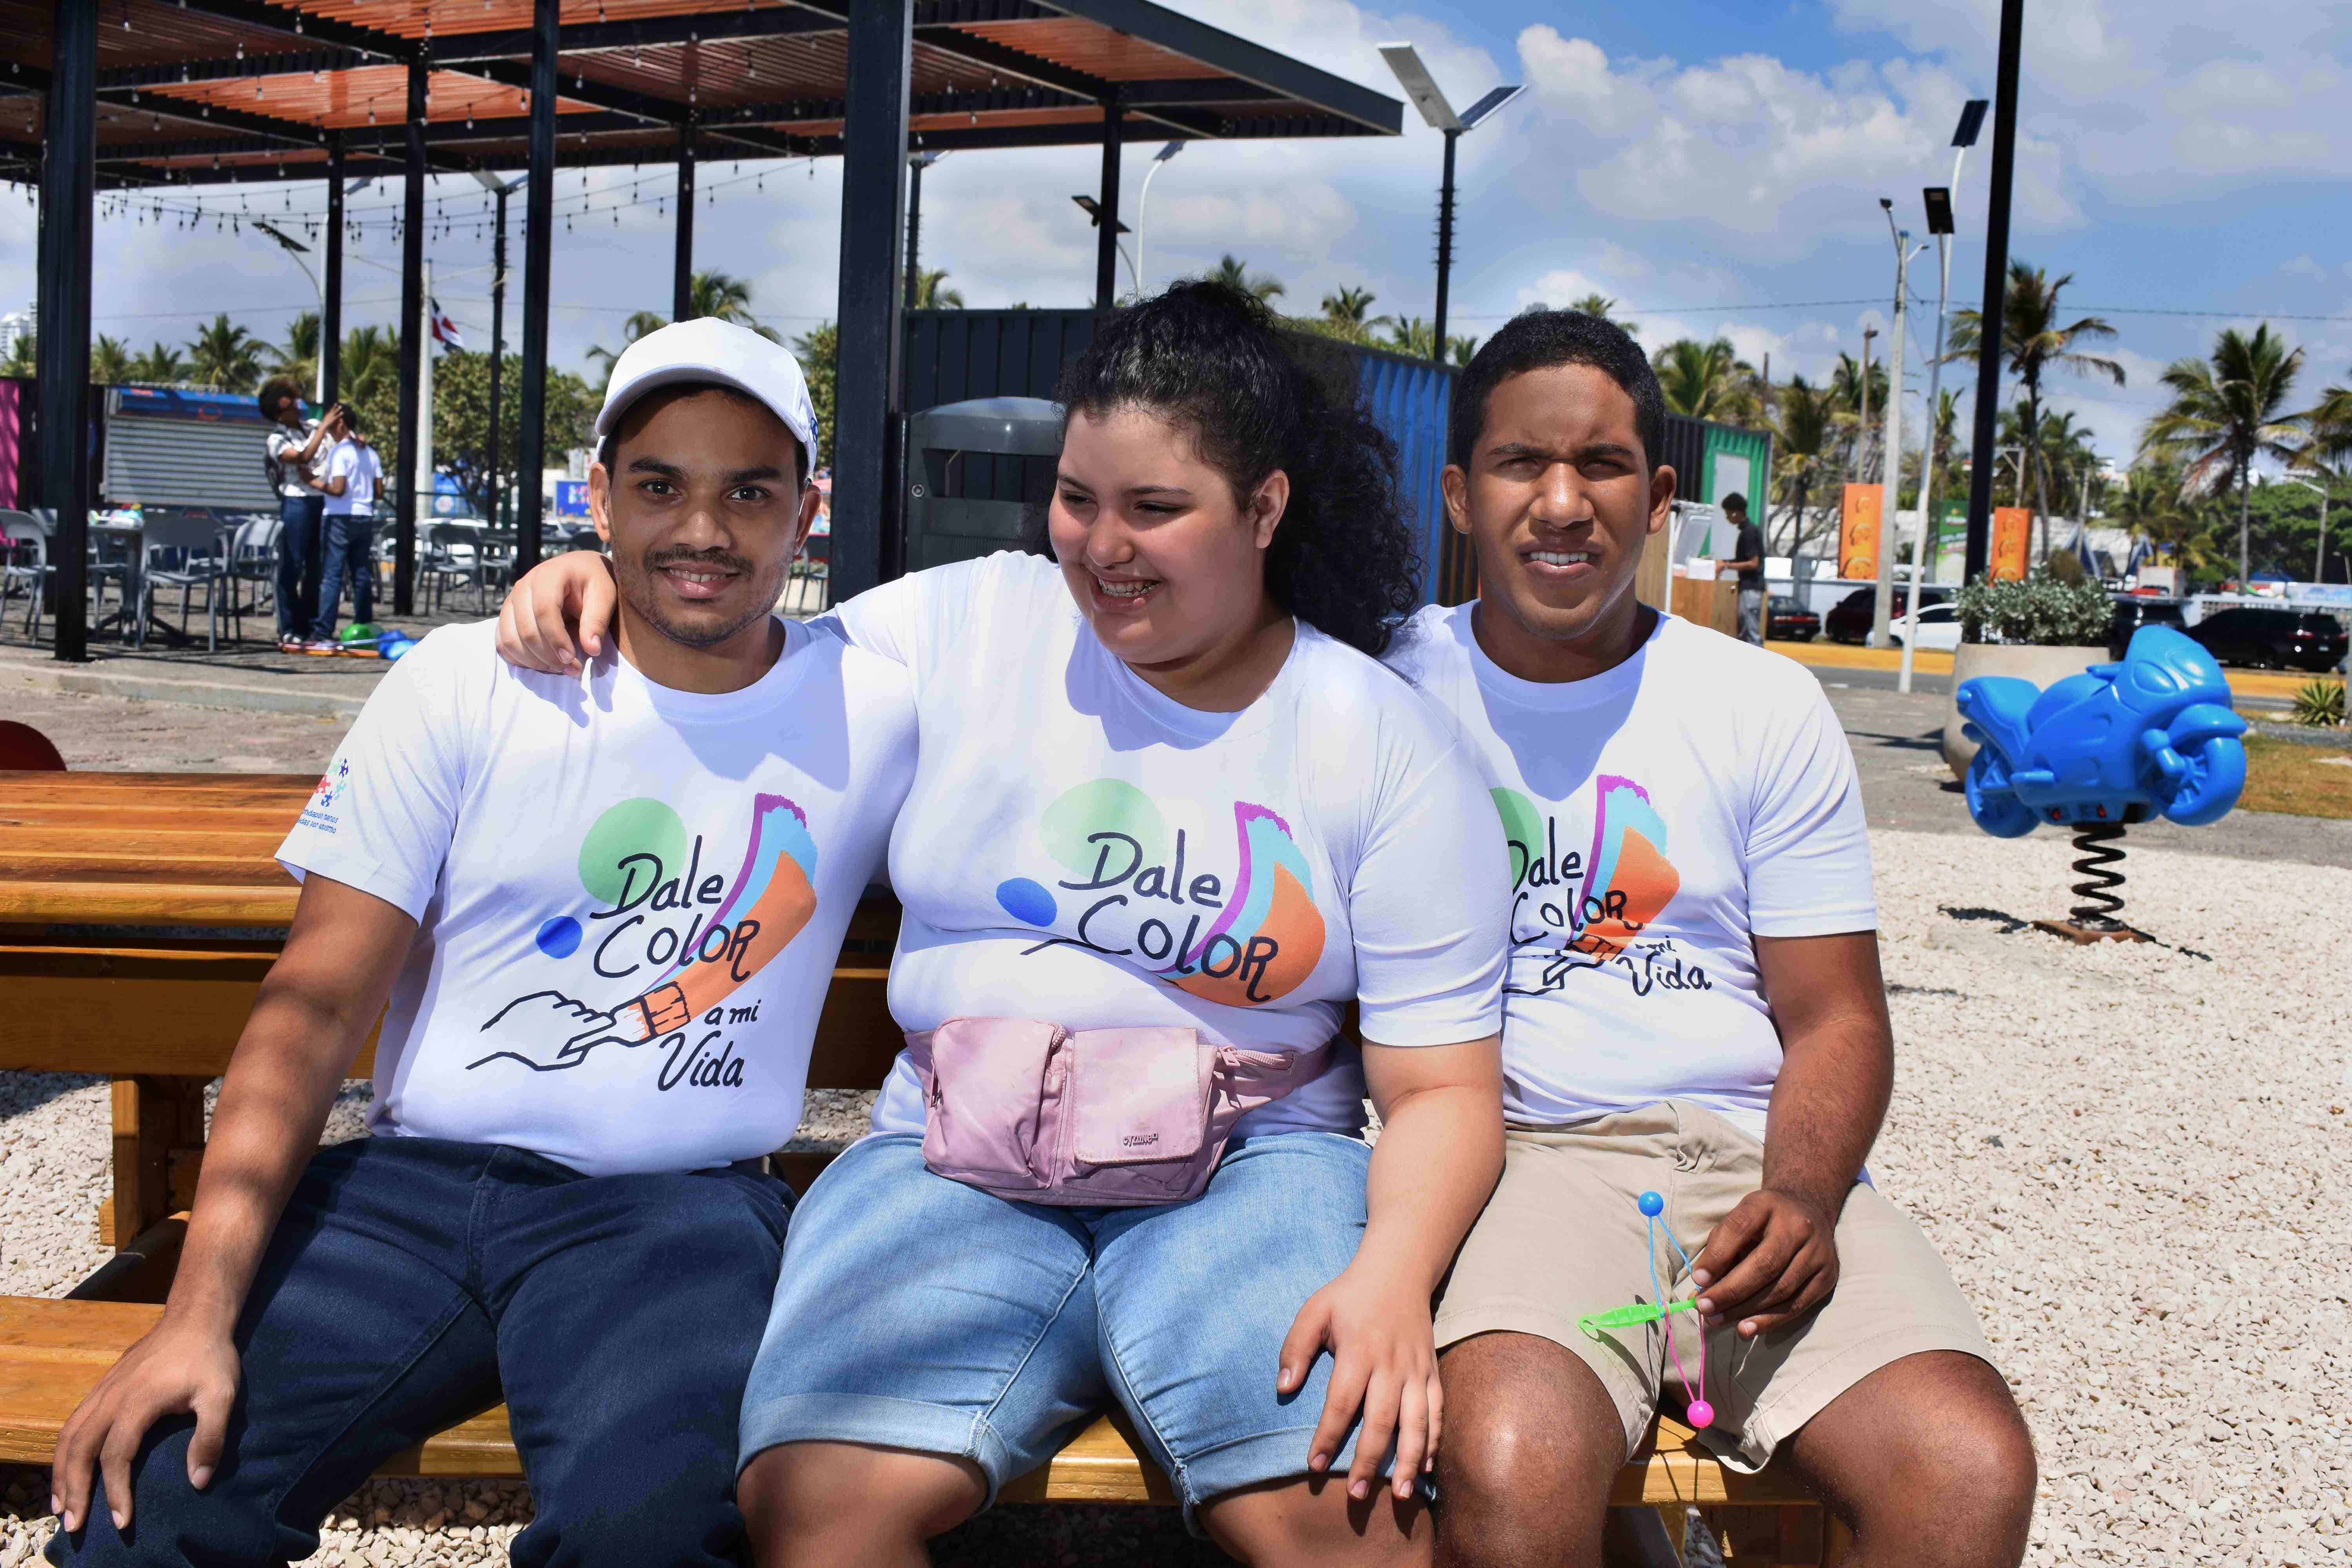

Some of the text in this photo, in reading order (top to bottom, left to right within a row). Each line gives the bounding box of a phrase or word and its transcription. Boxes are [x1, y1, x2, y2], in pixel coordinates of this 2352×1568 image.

[590, 835, 724, 919] Dale
[1058, 829, 1223, 909] Dale
[1615, 950, 1712, 996] Vida
[704, 999, 762, 1025] a mi
[657, 1030, 746, 1091] Vida
